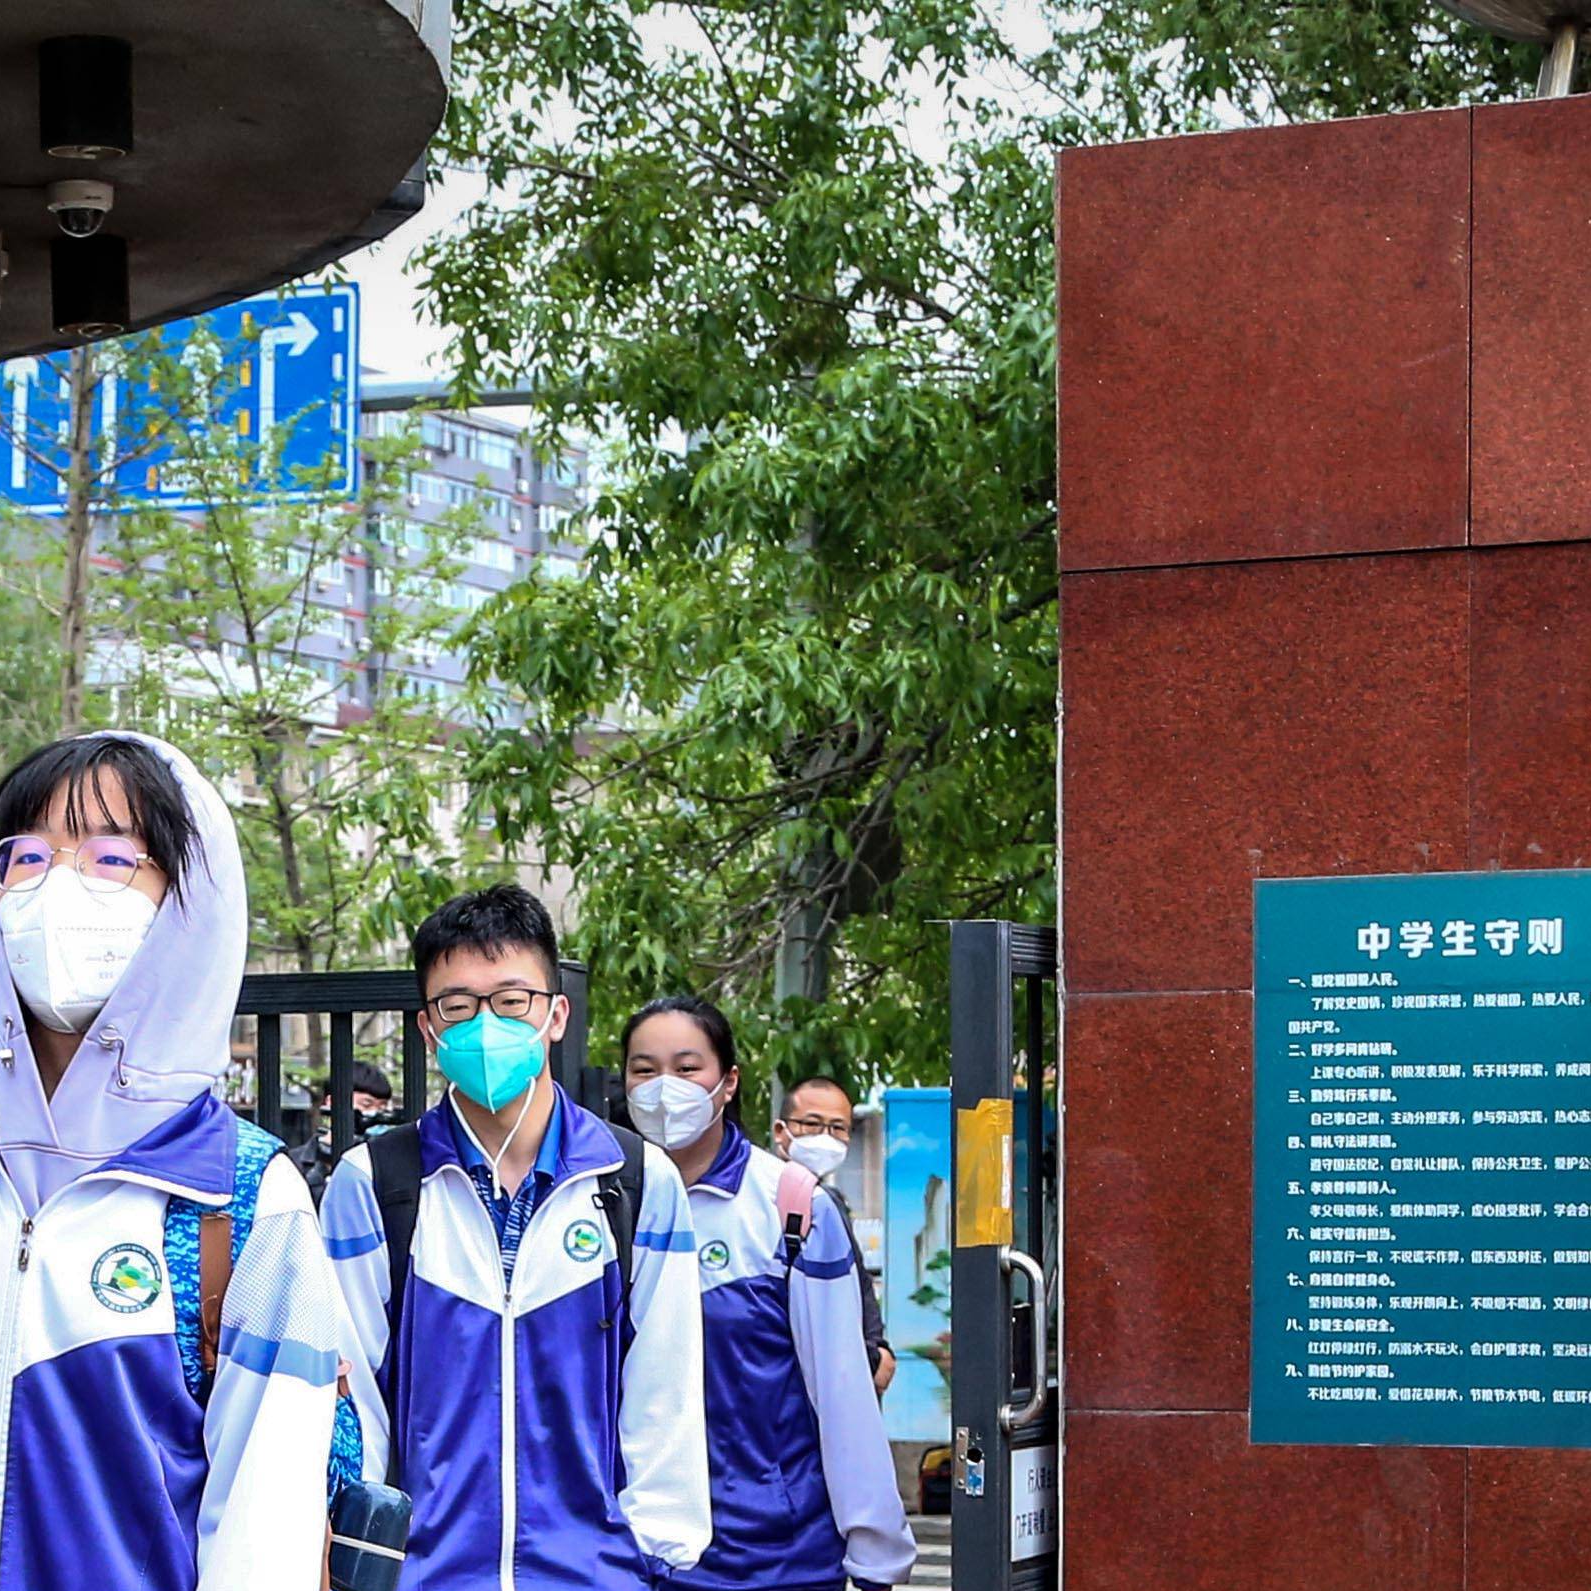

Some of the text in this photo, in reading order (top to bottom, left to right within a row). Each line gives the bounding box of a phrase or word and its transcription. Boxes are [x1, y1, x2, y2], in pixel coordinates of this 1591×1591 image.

[1358, 918, 1563, 959] 中学生守则
